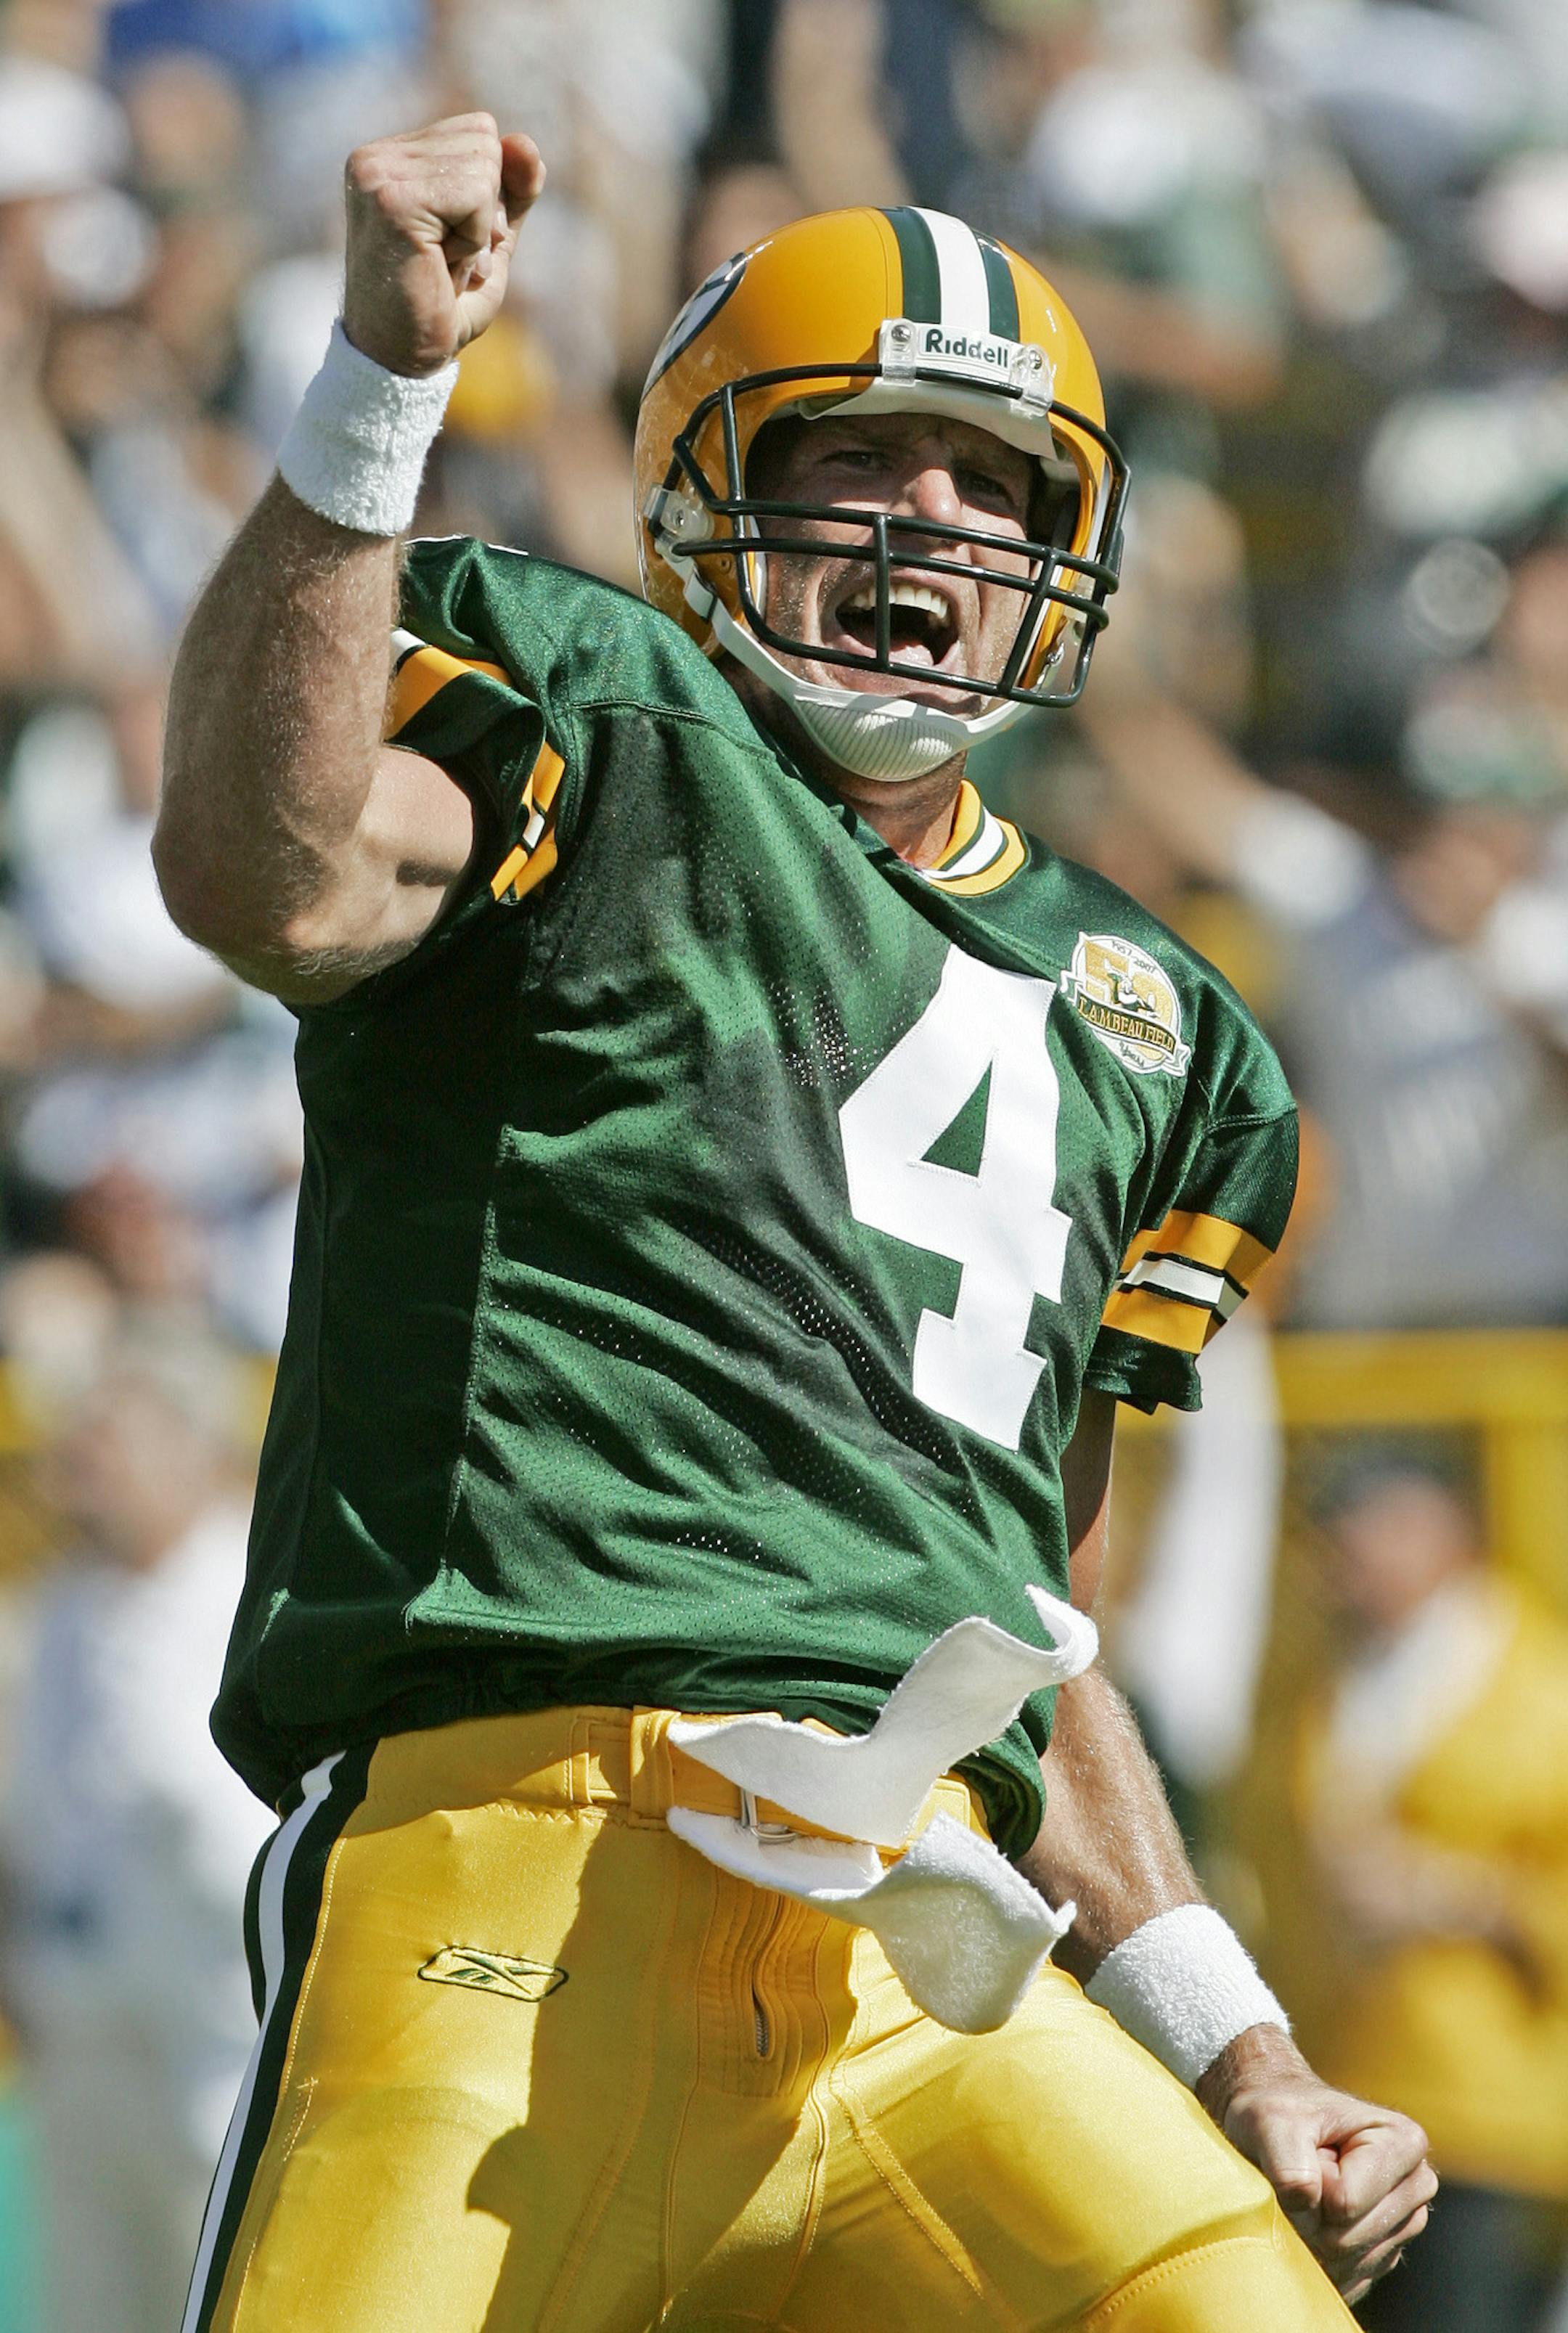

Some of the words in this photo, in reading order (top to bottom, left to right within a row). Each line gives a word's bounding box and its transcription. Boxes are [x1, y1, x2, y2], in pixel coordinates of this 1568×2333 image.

[925, 328, 1008, 368] Riddell
[1079, 996, 1145, 1040] LAMBEAU
[1145, 1024, 1175, 1051] FIELD
[838, 943, 1073, 1452] 4
